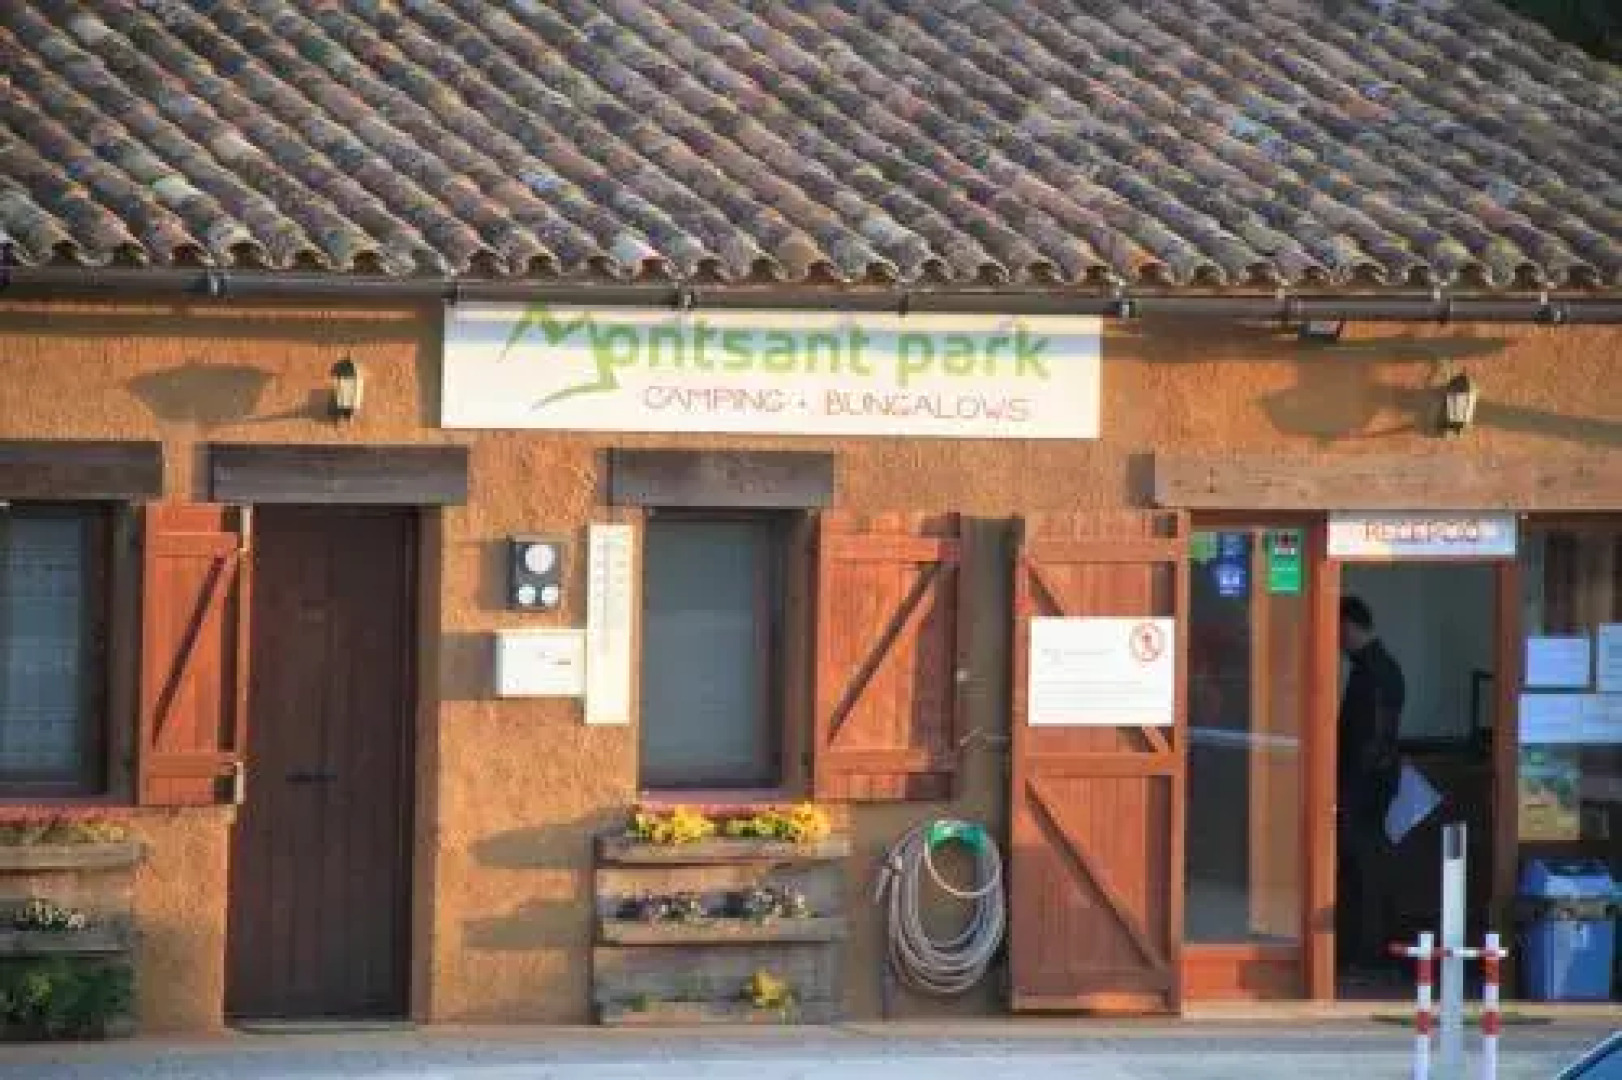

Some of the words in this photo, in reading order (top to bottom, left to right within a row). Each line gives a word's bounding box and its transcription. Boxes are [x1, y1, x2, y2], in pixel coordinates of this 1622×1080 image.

[497, 299, 872, 411] Montsant
[897, 322, 1051, 387] park
[644, 385, 786, 414] CAMPING
[826, 388, 1032, 422] BUNGALOWS
